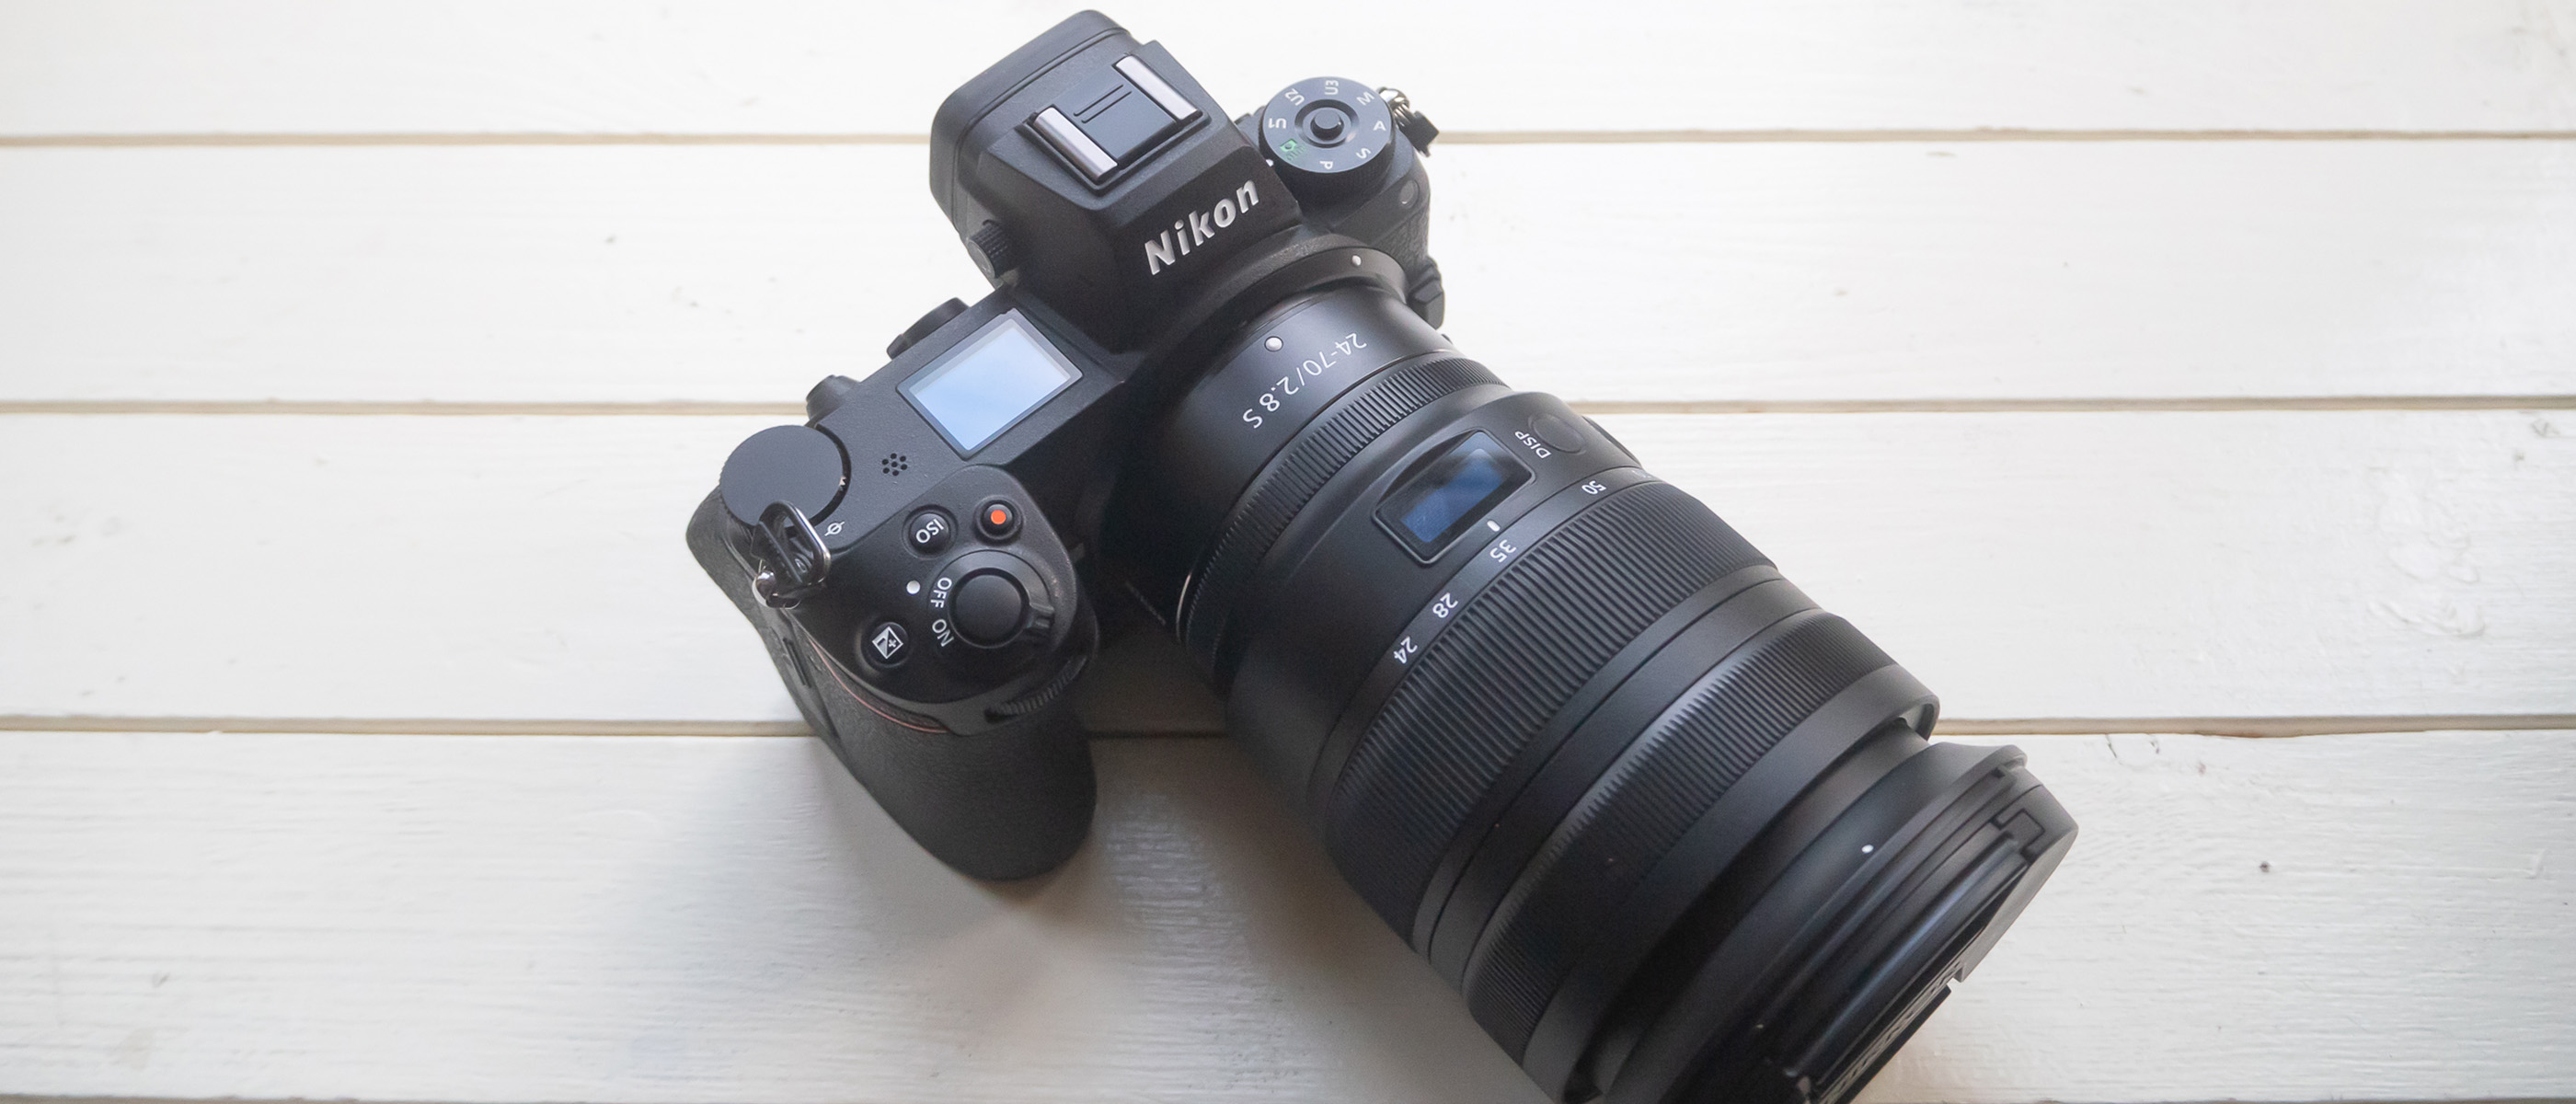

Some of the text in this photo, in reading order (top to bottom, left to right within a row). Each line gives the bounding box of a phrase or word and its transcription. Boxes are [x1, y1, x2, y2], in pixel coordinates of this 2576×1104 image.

[1284, 88, 1305, 106] U2
[1325, 80, 1339, 95] U3
[1356, 91, 1374, 106] M
[1268, 118, 1287, 129] U1
[1373, 121, 1386, 132] A
[1319, 160, 1334, 169] P
[1356, 147, 1371, 159] S
[1144, 179, 1259, 275] Nikon
[1242, 332, 1368, 429] 24-70/2.8 S
[1514, 430, 1552, 459] DISP
[1581, 480, 1607, 495] 50
[915, 518, 944, 543] ISO
[1489, 539, 1517, 563] 35
[930, 577, 952, 608] OFF
[1432, 592, 1459, 618] 28
[931, 618, 954, 648] ON
[1393, 636, 1419, 664] 24
